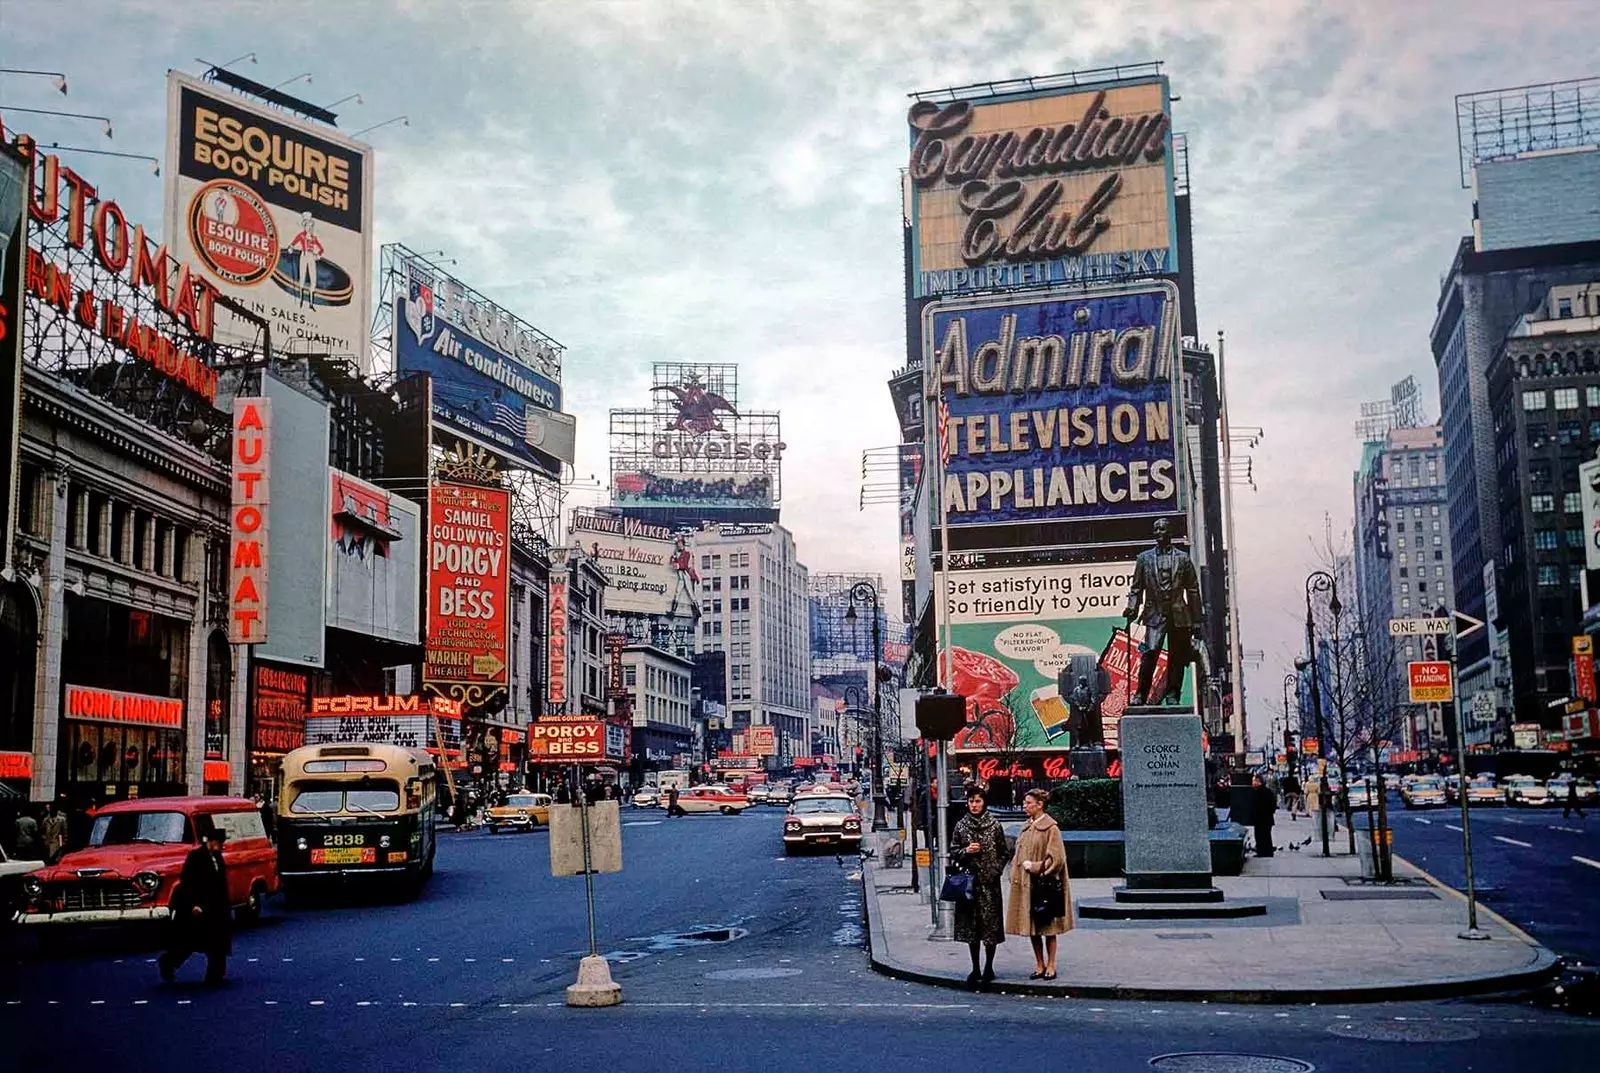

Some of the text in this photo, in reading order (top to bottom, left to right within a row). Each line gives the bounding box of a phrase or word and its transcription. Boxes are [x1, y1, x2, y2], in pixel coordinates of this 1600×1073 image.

[195, 107, 349, 192] ESQUIRE
[194, 143, 263, 182] BOOT
[269, 169, 349, 211] POLISH
[208, 220, 269, 251] ESQUIRE
[208, 240, 267, 266] BOOT POLISH
[921, 249, 1168, 296] IMPORTED WHISKY
[251, 301, 265, 313] IN
[277, 323, 290, 335] IN
[296, 328, 349, 350] QUALITY!
[926, 300, 1175, 398] Admiral
[434, 328, 554, 409] Air conditioners
[948, 401, 1170, 456] TELEVISION
[944, 459, 1175, 513] APPLIANCES
[234, 404, 264, 638] AUTOMAT
[444, 508, 494, 529] SAMUEL
[567, 509, 670, 540] JOHNNIE WALKER
[433, 525, 504, 547] GOLDWYN'S
[432, 541, 502, 577] PORGY
[628, 547, 664, 565] WHISKY
[455, 576, 481, 587] AND
[617, 580, 638, 592] going
[641, 582, 667, 595] strong!
[948, 580, 976, 595] Get
[982, 575, 1072, 595] satisfying
[440, 586, 495, 620] BESS
[948, 601, 968, 615] So
[973, 596, 1045, 616] friendly
[1052, 595, 1071, 610] to
[1077, 594, 1121, 612] your
[438, 628, 496, 640] TECHNICOLOR
[1392, 620, 1450, 633] ONE WAY
[551, 584, 566, 700] WARNER
[428, 650, 471, 666] WARNER
[430, 666, 470, 677] THEATRE
[1414, 673, 1447, 684] STANDING
[1421, 666, 1439, 675] NO
[1415, 686, 1449, 697] BUS STOP
[123, 696, 183, 725] HARDART
[313, 695, 419, 713] FORUM
[339, 725, 400, 733] DAVID WAYNE
[369, 717, 391, 725] MUNI
[337, 733, 359, 741] LAST
[363, 732, 391, 741] ANGRY
[534, 725, 598, 738] PORGY
[558, 735, 572, 743] and
[549, 741, 600, 754] BESS
[1143, 745, 1180, 753] GEORGE
[1147, 761, 1179, 769] COHAN
[323, 834, 365, 846] 2838
